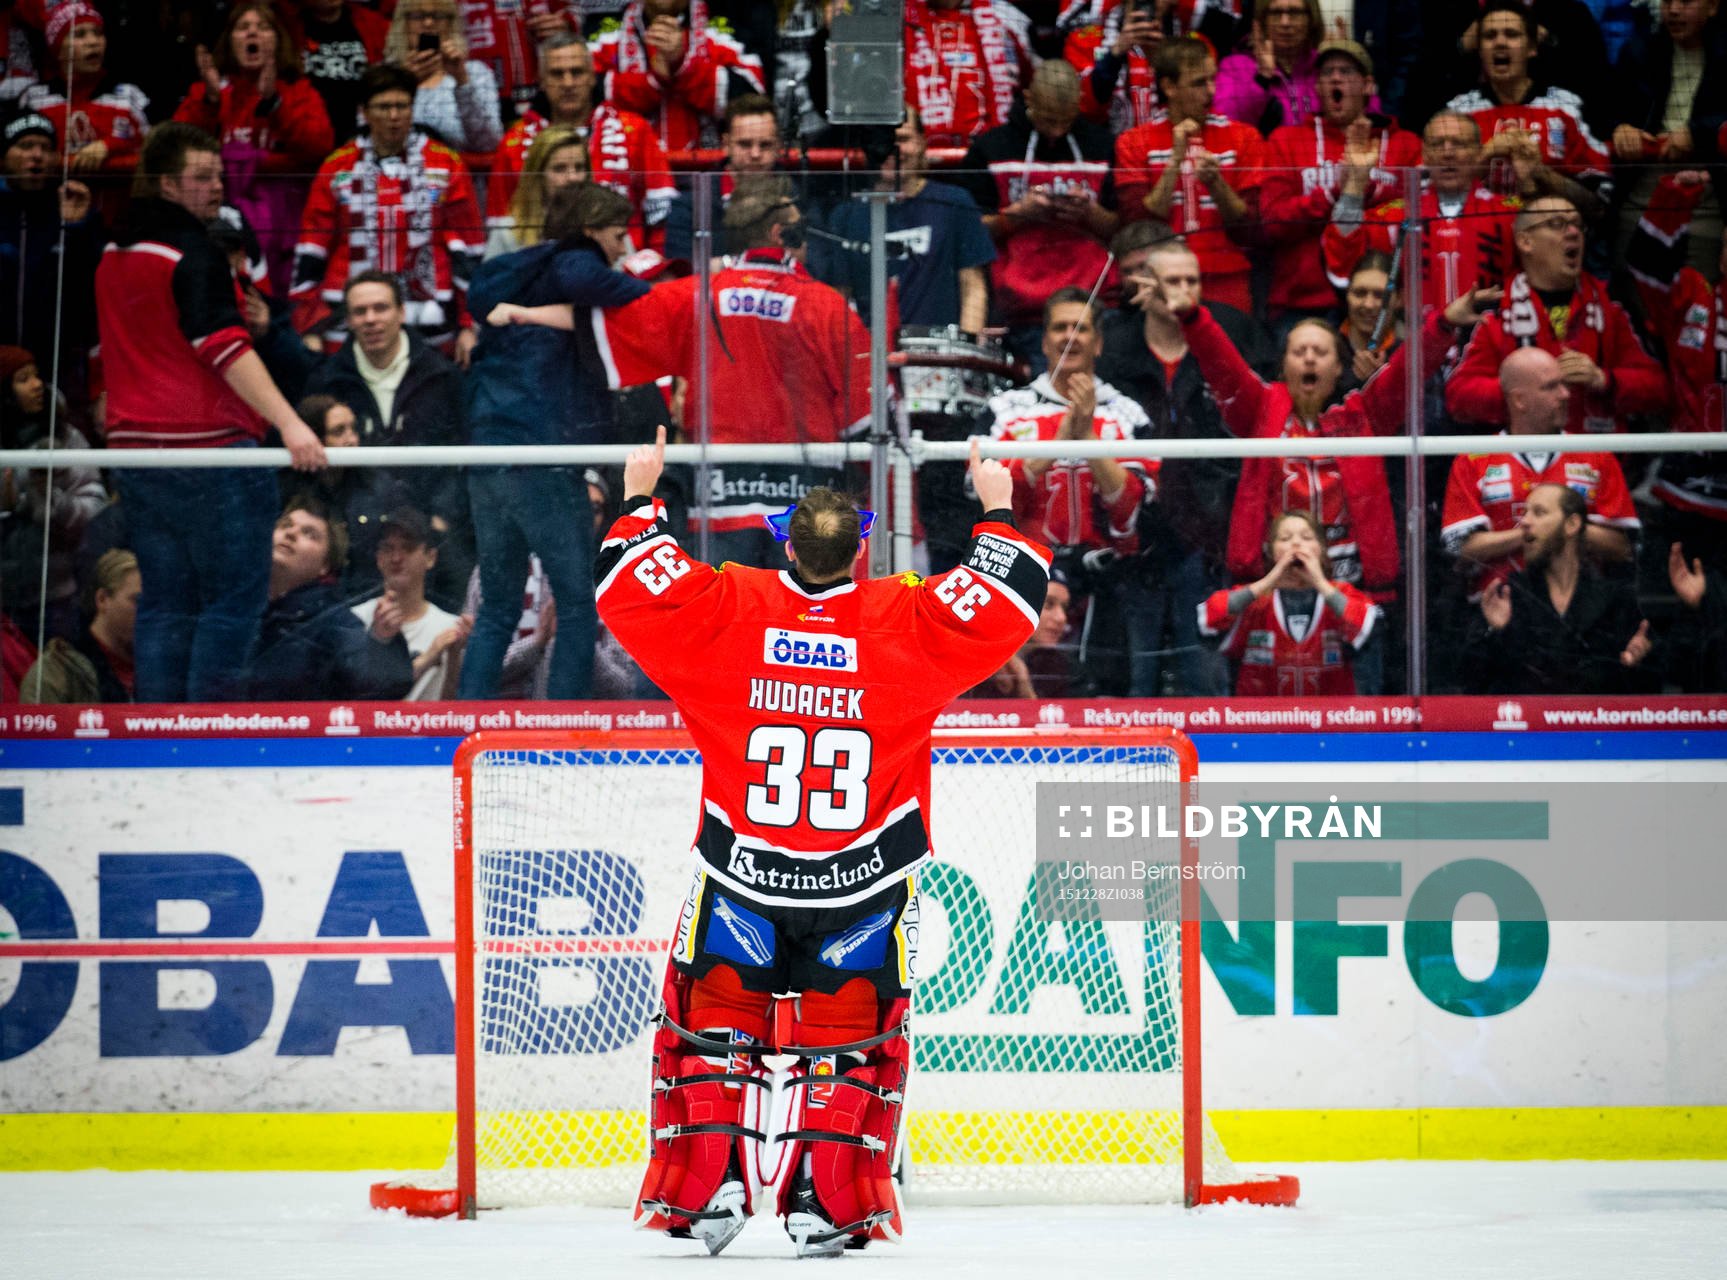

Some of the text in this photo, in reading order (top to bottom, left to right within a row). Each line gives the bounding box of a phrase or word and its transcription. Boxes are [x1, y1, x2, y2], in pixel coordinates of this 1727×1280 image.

[633, 544, 691, 596] 33
[989, 549, 1014, 568] SOM
[990, 564, 1010, 579] DET
[933, 567, 992, 622] 33
[773, 631, 848, 668] ÖBAB
[748, 677, 865, 720] HUDACEK
[14, 714, 57, 732] 1996
[125, 713, 310, 731] www.kornboden.se
[374, 710, 476, 732] Rekrytering
[479, 710, 511, 729] och
[515, 710, 612, 732] bemanning
[616, 710, 667, 729] sedan
[1083, 707, 1186, 729] Rekrytering
[1189, 707, 1220, 726] och
[1224, 706, 1322, 728] bemanning
[1326, 706, 1377, 724] sedan
[1543, 704, 1727, 724] www.kornboden.se
[745, 724, 873, 832] 33
[727, 845, 885, 890] Katrinelund
